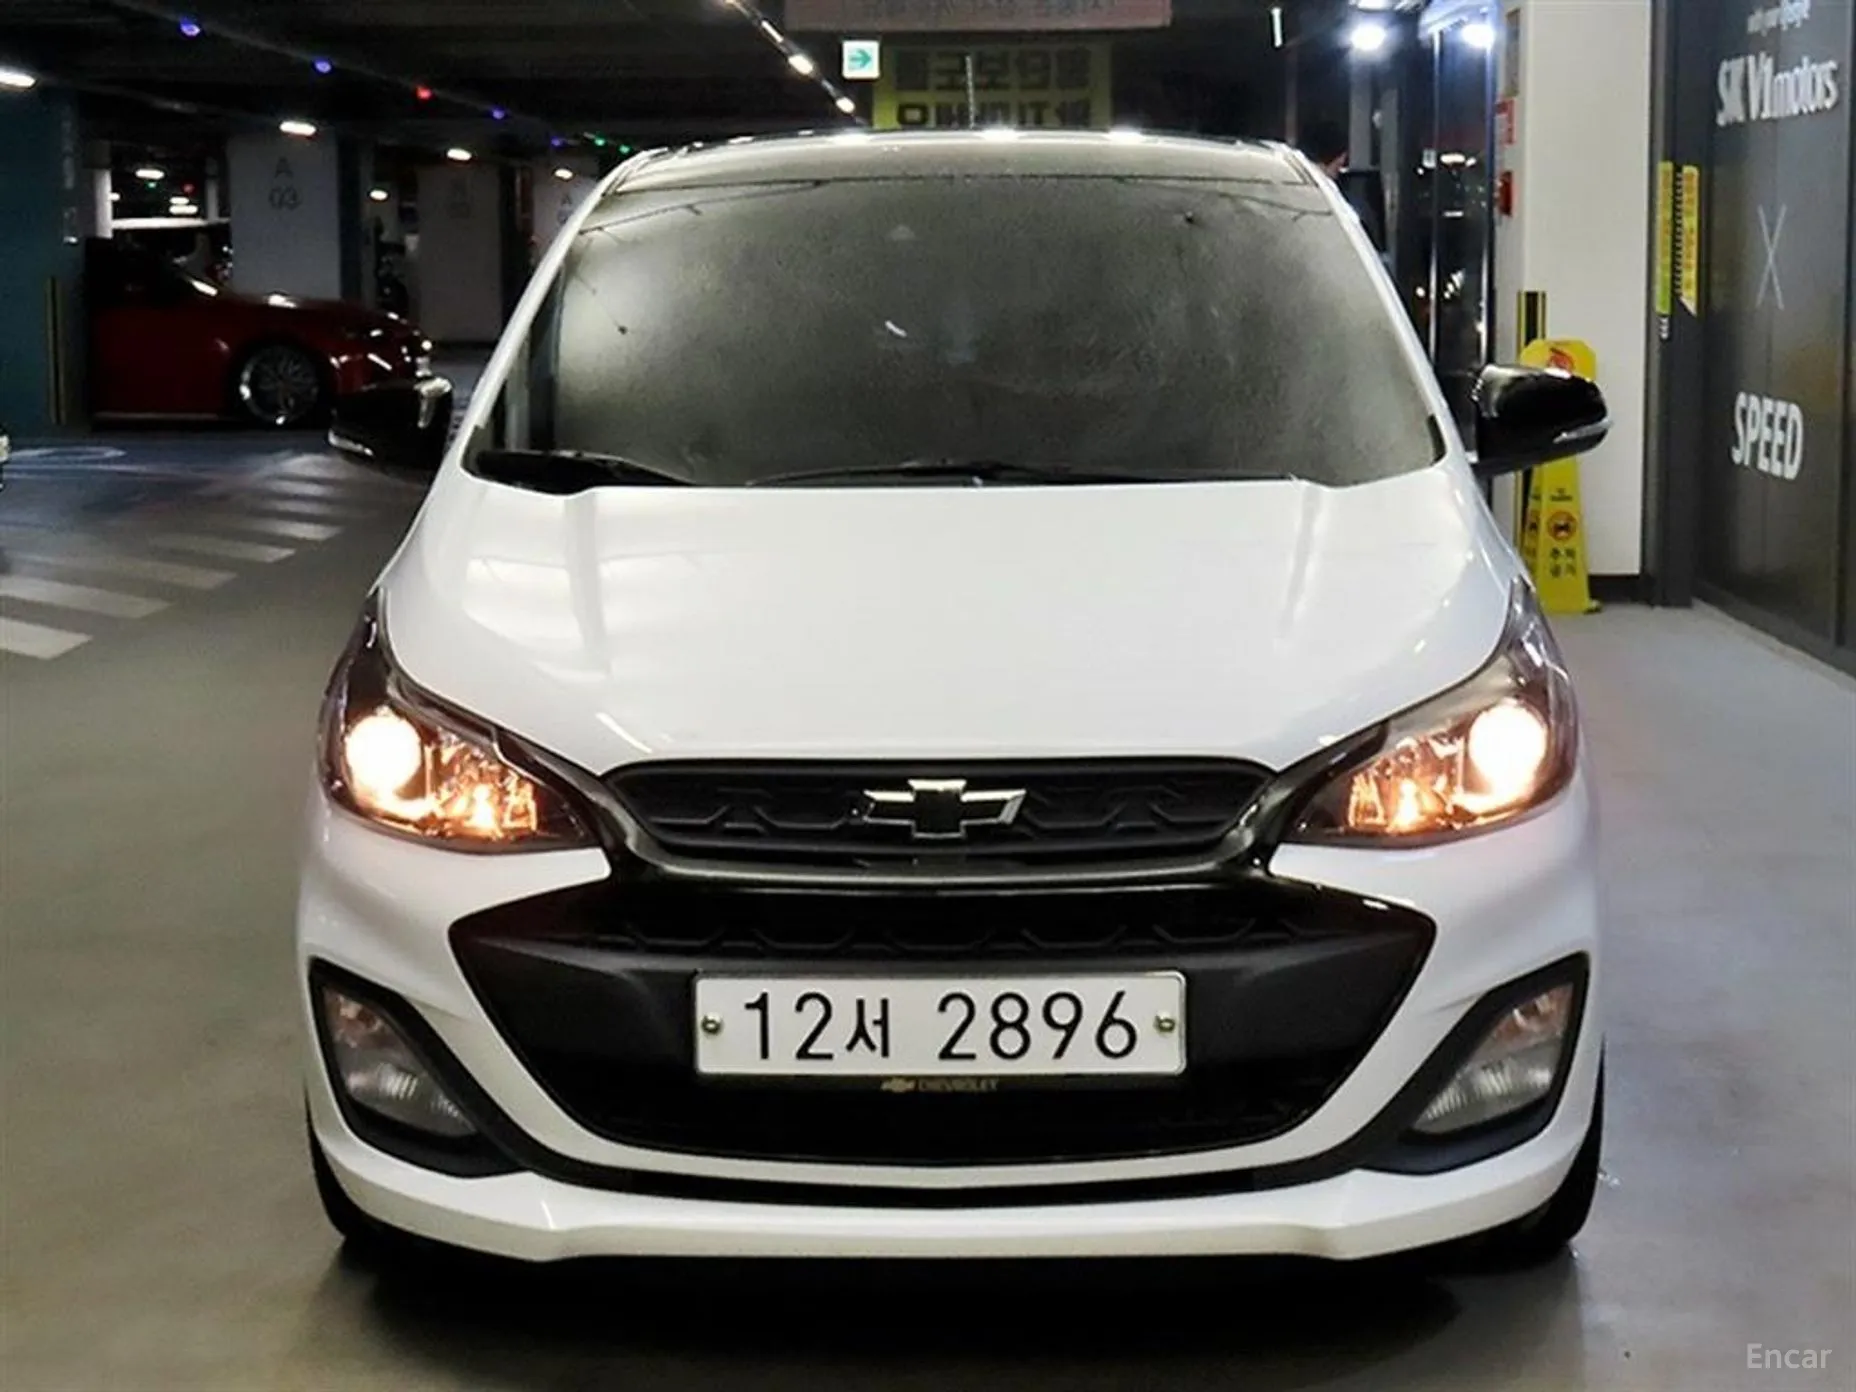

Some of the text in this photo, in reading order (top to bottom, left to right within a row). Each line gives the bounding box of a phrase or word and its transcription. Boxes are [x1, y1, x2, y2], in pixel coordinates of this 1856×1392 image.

[1731, 391, 1804, 481] SPEED
[744, 990, 1138, 1060] 12서 2896
[918, 1079, 999, 1092] CHEVROLET
